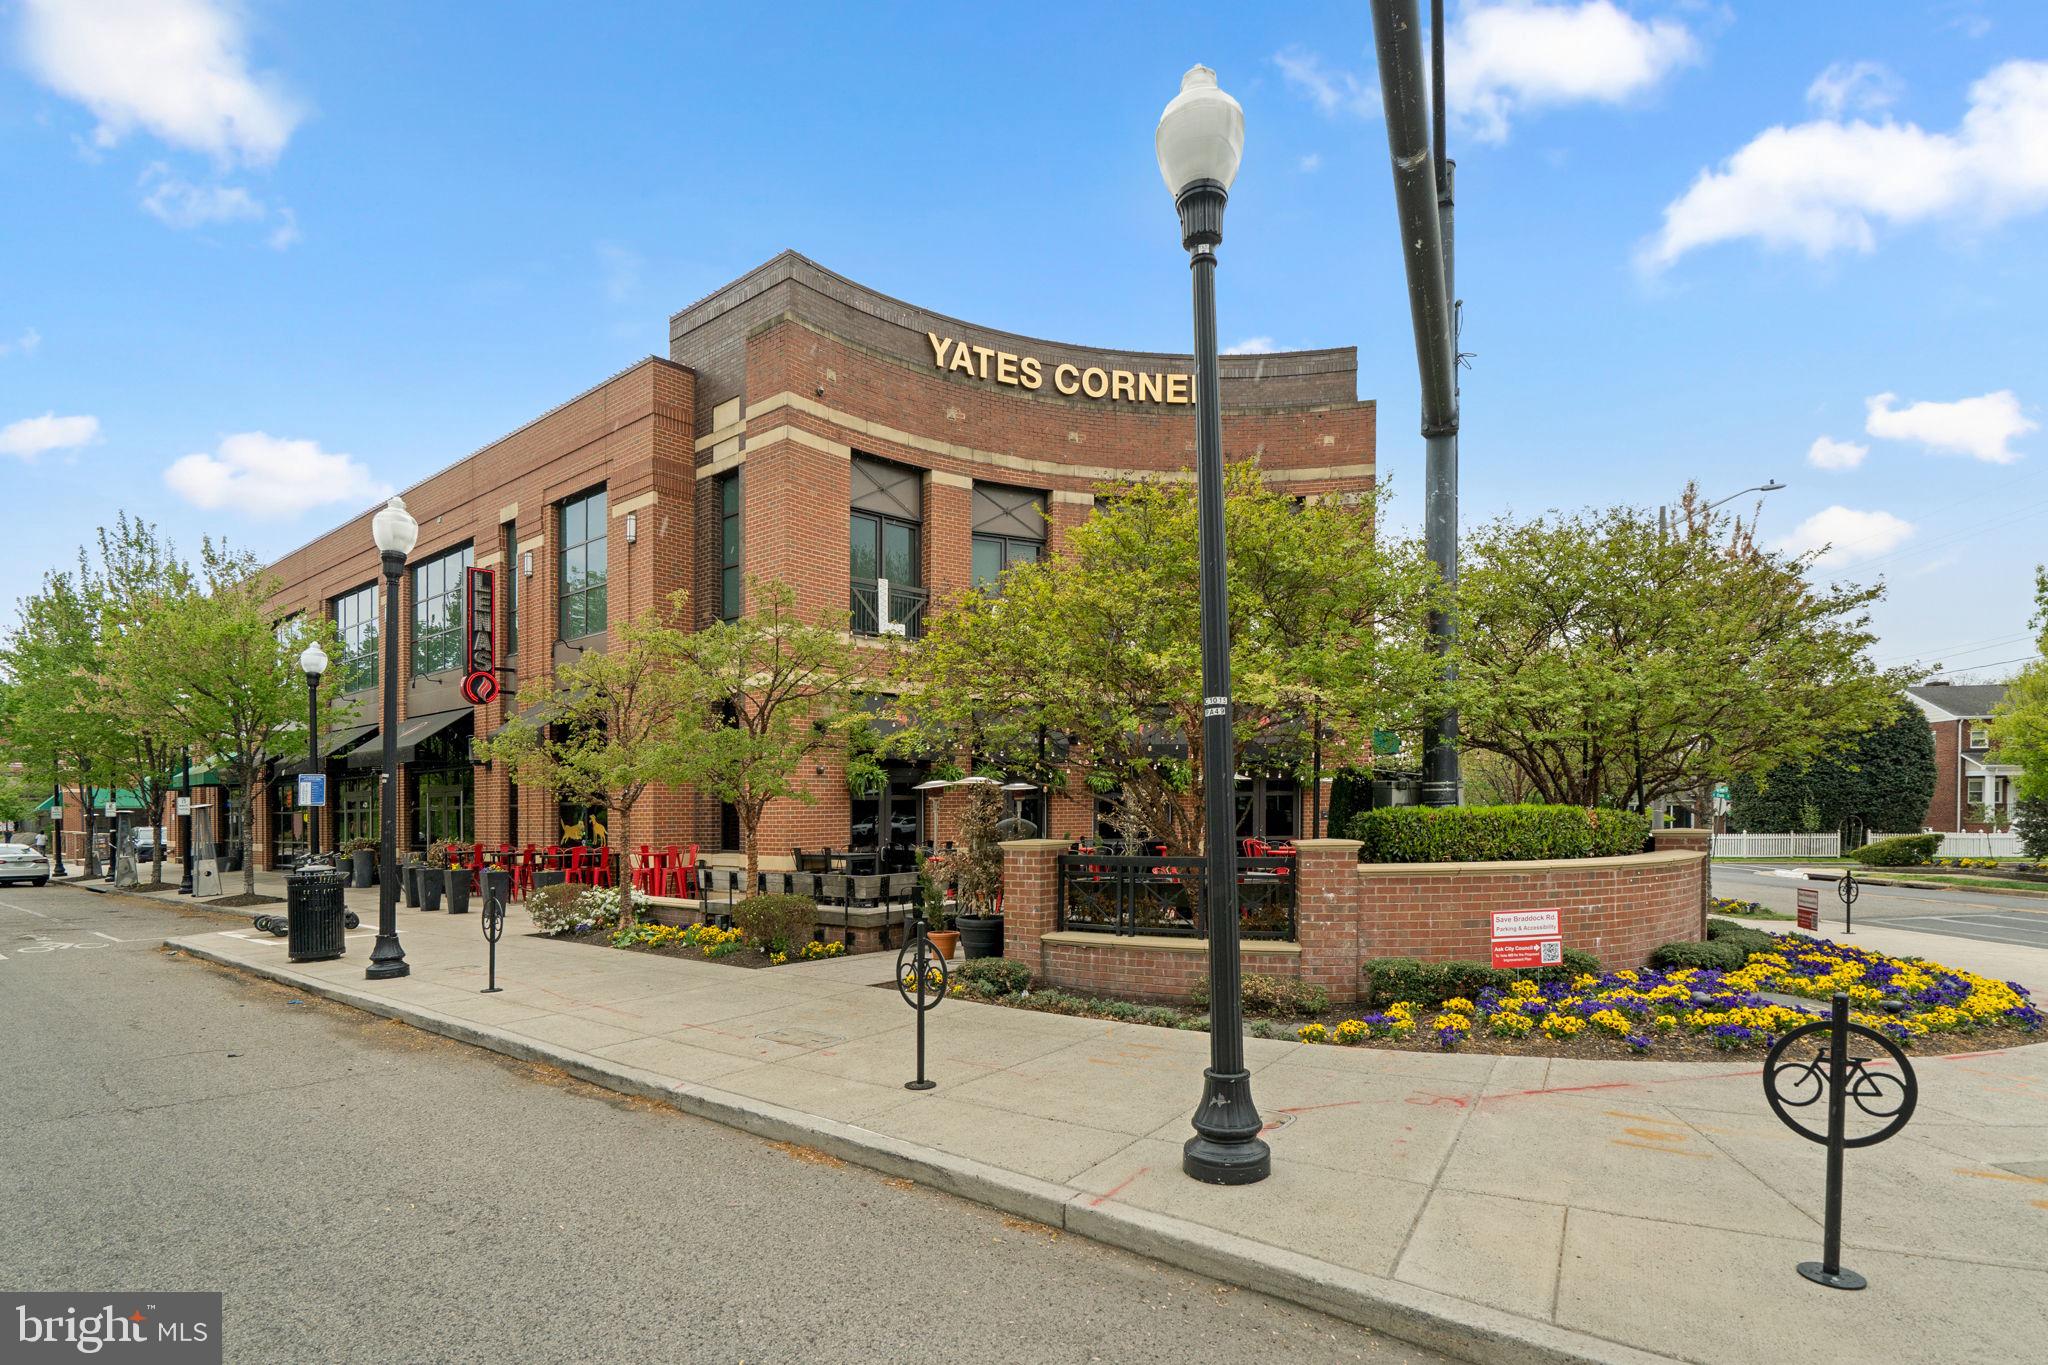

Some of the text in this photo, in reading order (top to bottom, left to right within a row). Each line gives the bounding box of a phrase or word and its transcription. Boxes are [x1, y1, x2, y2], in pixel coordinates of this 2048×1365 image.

[928, 331, 1043, 390] YATES
[474, 571, 492, 671] LENAS
[1513, 914, 1544, 922] Braddock
